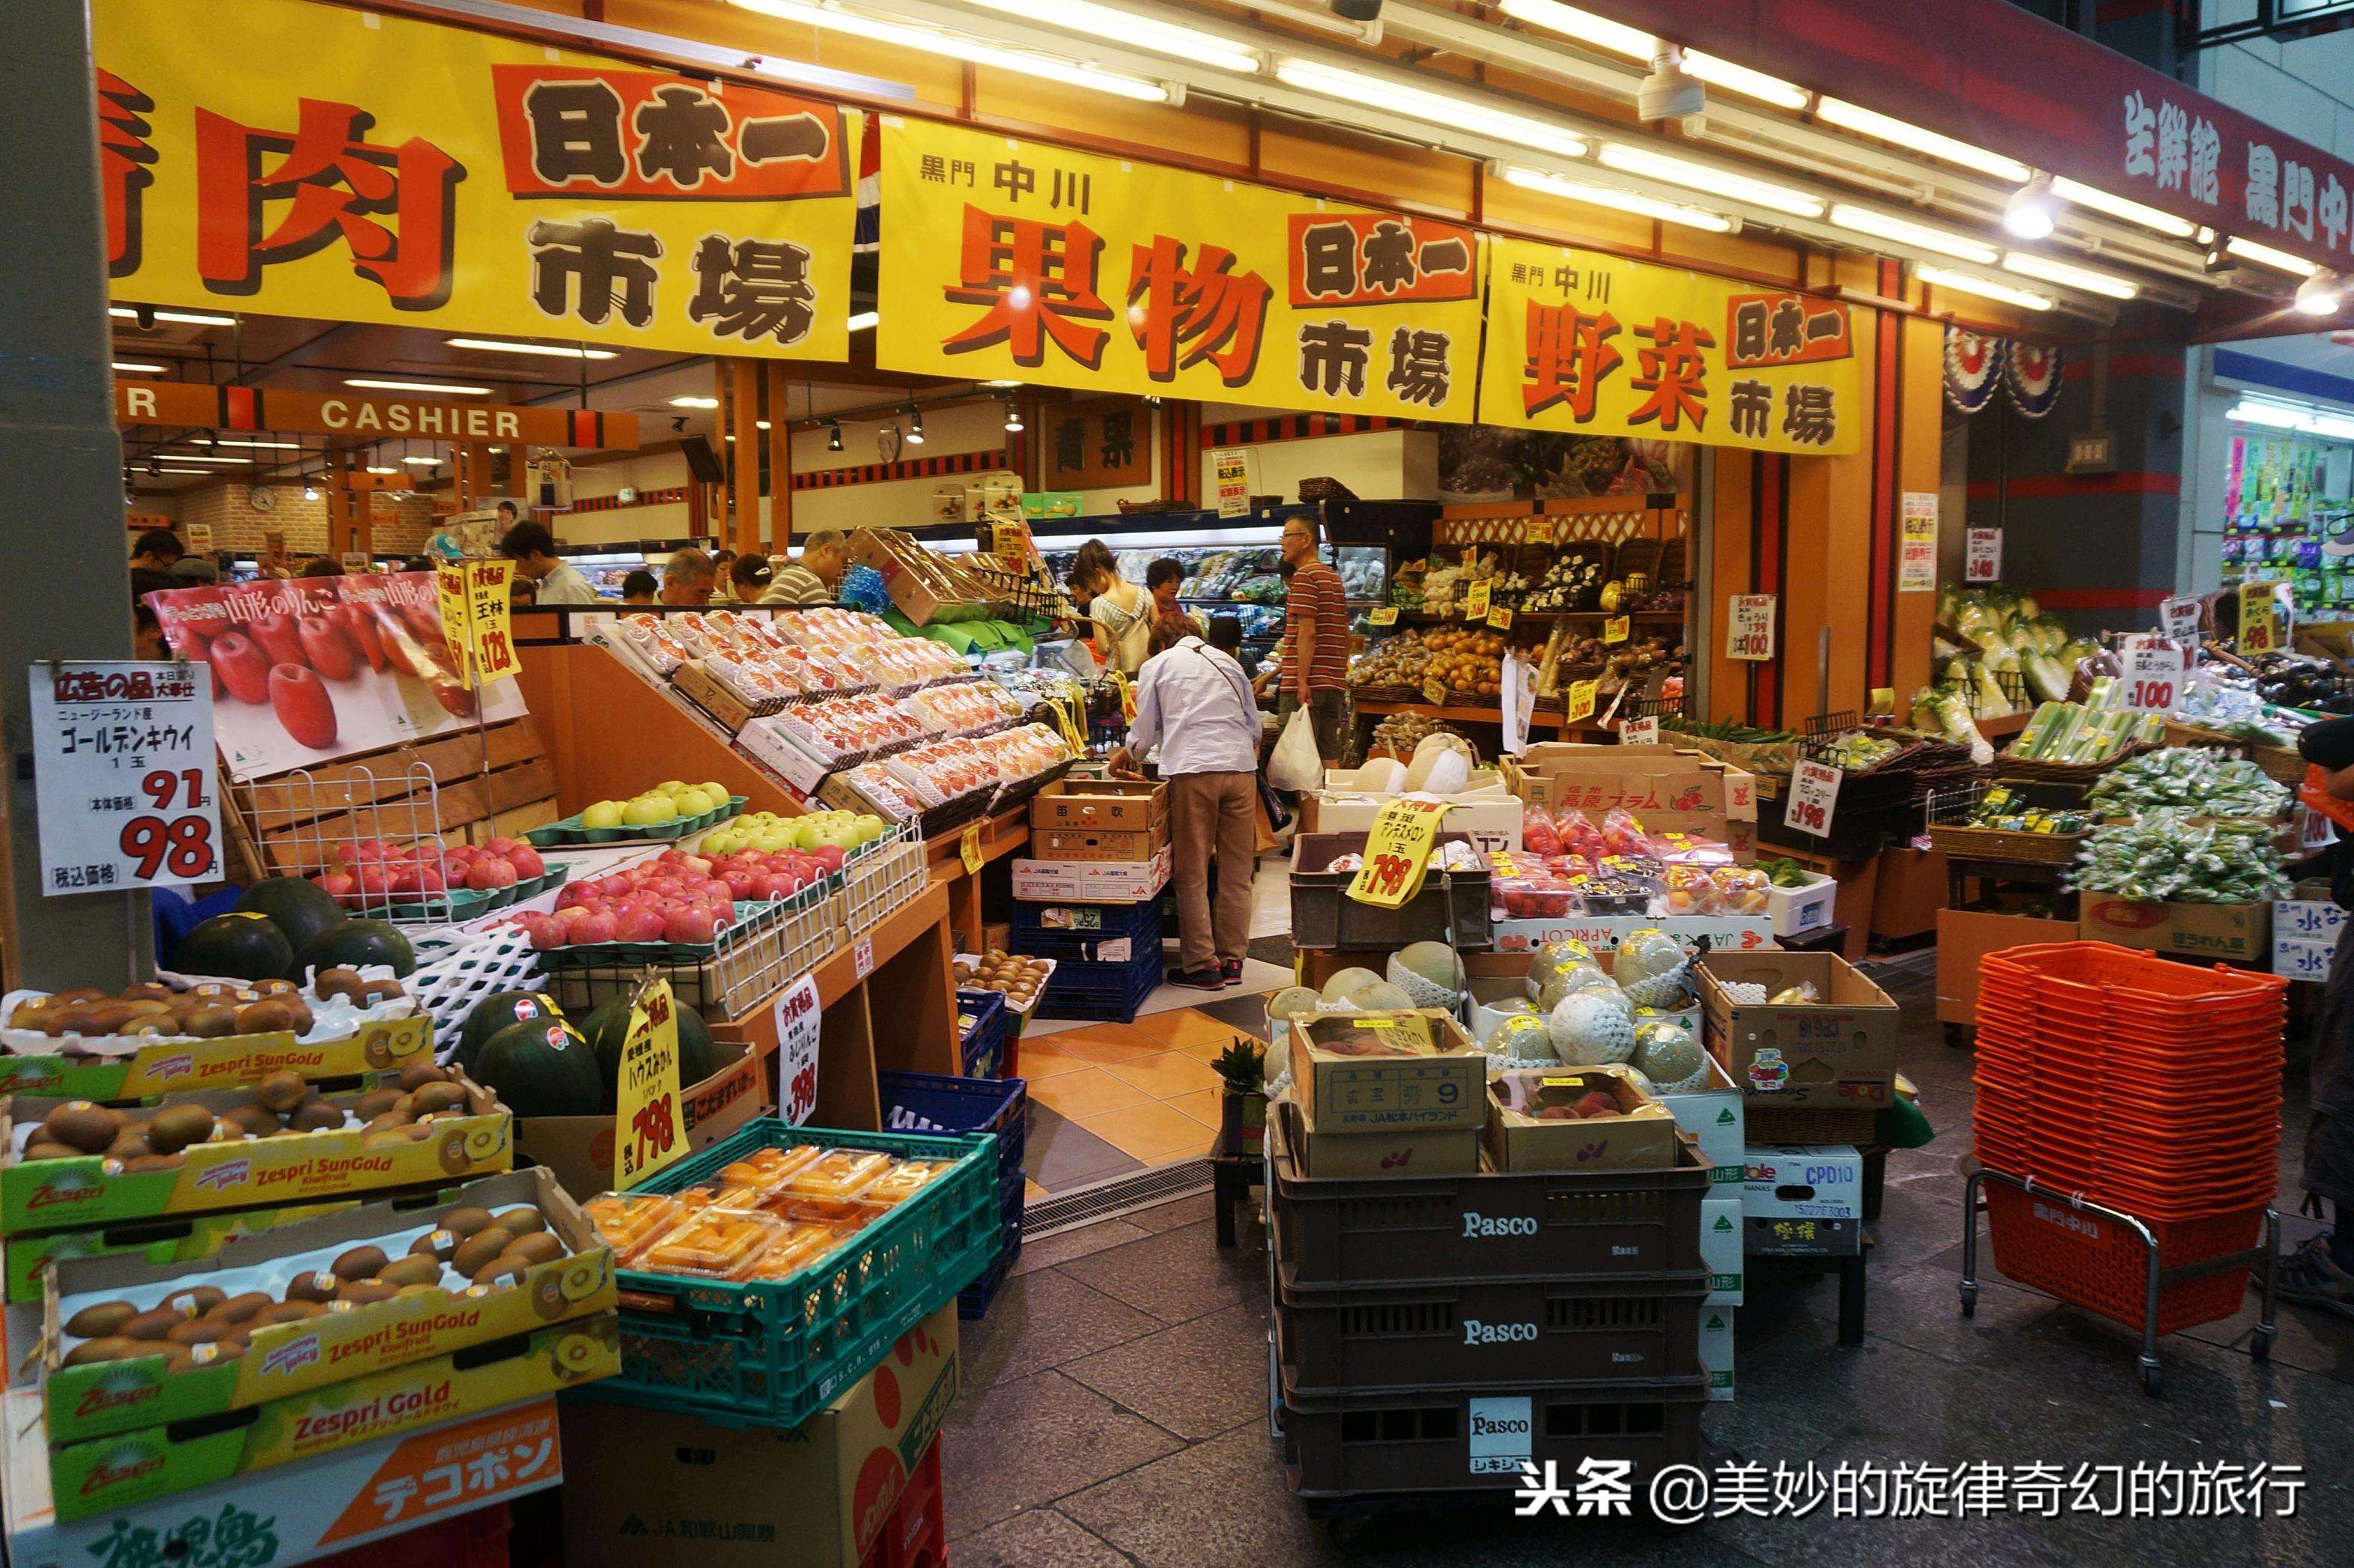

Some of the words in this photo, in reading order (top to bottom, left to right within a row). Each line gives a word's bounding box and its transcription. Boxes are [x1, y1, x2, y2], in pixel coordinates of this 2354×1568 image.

[524, 77, 830, 189] 日本一
[97, 66, 467, 312] 肉
[919, 154, 976, 189] 黒門
[994, 159, 1091, 216] 中川
[2245, 141, 2354, 255] 黒門中
[1301, 218, 1469, 297] 日本一
[526, 216, 816, 347] 市場
[941, 201, 1274, 387] 果物
[1511, 262, 1545, 287] 黒門
[1554, 264, 1611, 303] 中川
[1735, 299, 1844, 362] 日本一
[1296, 320, 1452, 407] 市場
[1522, 297, 1717, 432] 野菜
[320, 400, 520, 439] CASHIER
[1730, 380, 1838, 446] 市場
[224, 588, 336, 623] 山形のりんご
[476, 599, 504, 619] 王林
[481, 630, 511, 672] 128
[1744, 633, 1768, 654] 100
[54, 672, 154, 702] 広告の品
[2135, 680, 2173, 708] 100
[58, 707, 153, 721] ニュージーランド産
[61, 725, 194, 754] ゴールデンキウイ
[142, 768, 203, 810] 91
[200, 796, 211, 806] 円
[1560, 789, 1662, 812] 高原プラム
[1796, 800, 1826, 830] 198
[120, 815, 215, 881] 98
[1366, 854, 1412, 896] 798
[1539, 928, 1612, 943] APRICOT
[199, 1054, 250, 1078] Zespri
[254, 1053, 324, 1066] SunGold
[629, 1042, 672, 1090] ハウスみかん
[791, 1062, 815, 1125] 798
[1438, 1083, 1459, 1104] 9
[632, 1093, 674, 1171] 798
[1370, 1110, 1459, 1123] JA松本ハイランド
[255, 1158, 314, 1188] Zespri
[318, 1156, 393, 1172] SunGold
[1805, 1165, 1854, 1185] CPD10
[26, 1183, 106, 1210] Zespri
[1462, 1212, 1538, 1239] Pasco
[329, 1325, 391, 1364] Zespri
[395, 1310, 481, 1339] SunGold
[1463, 1319, 1538, 1345] Pasco
[75, 1384, 162, 1418] Zespri
[294, 1397, 381, 1441] Zespri
[387, 1379, 451, 1415] Gold
[1472, 1411, 1529, 1436] Pasco
[374, 1437, 553, 1521] デコポン
